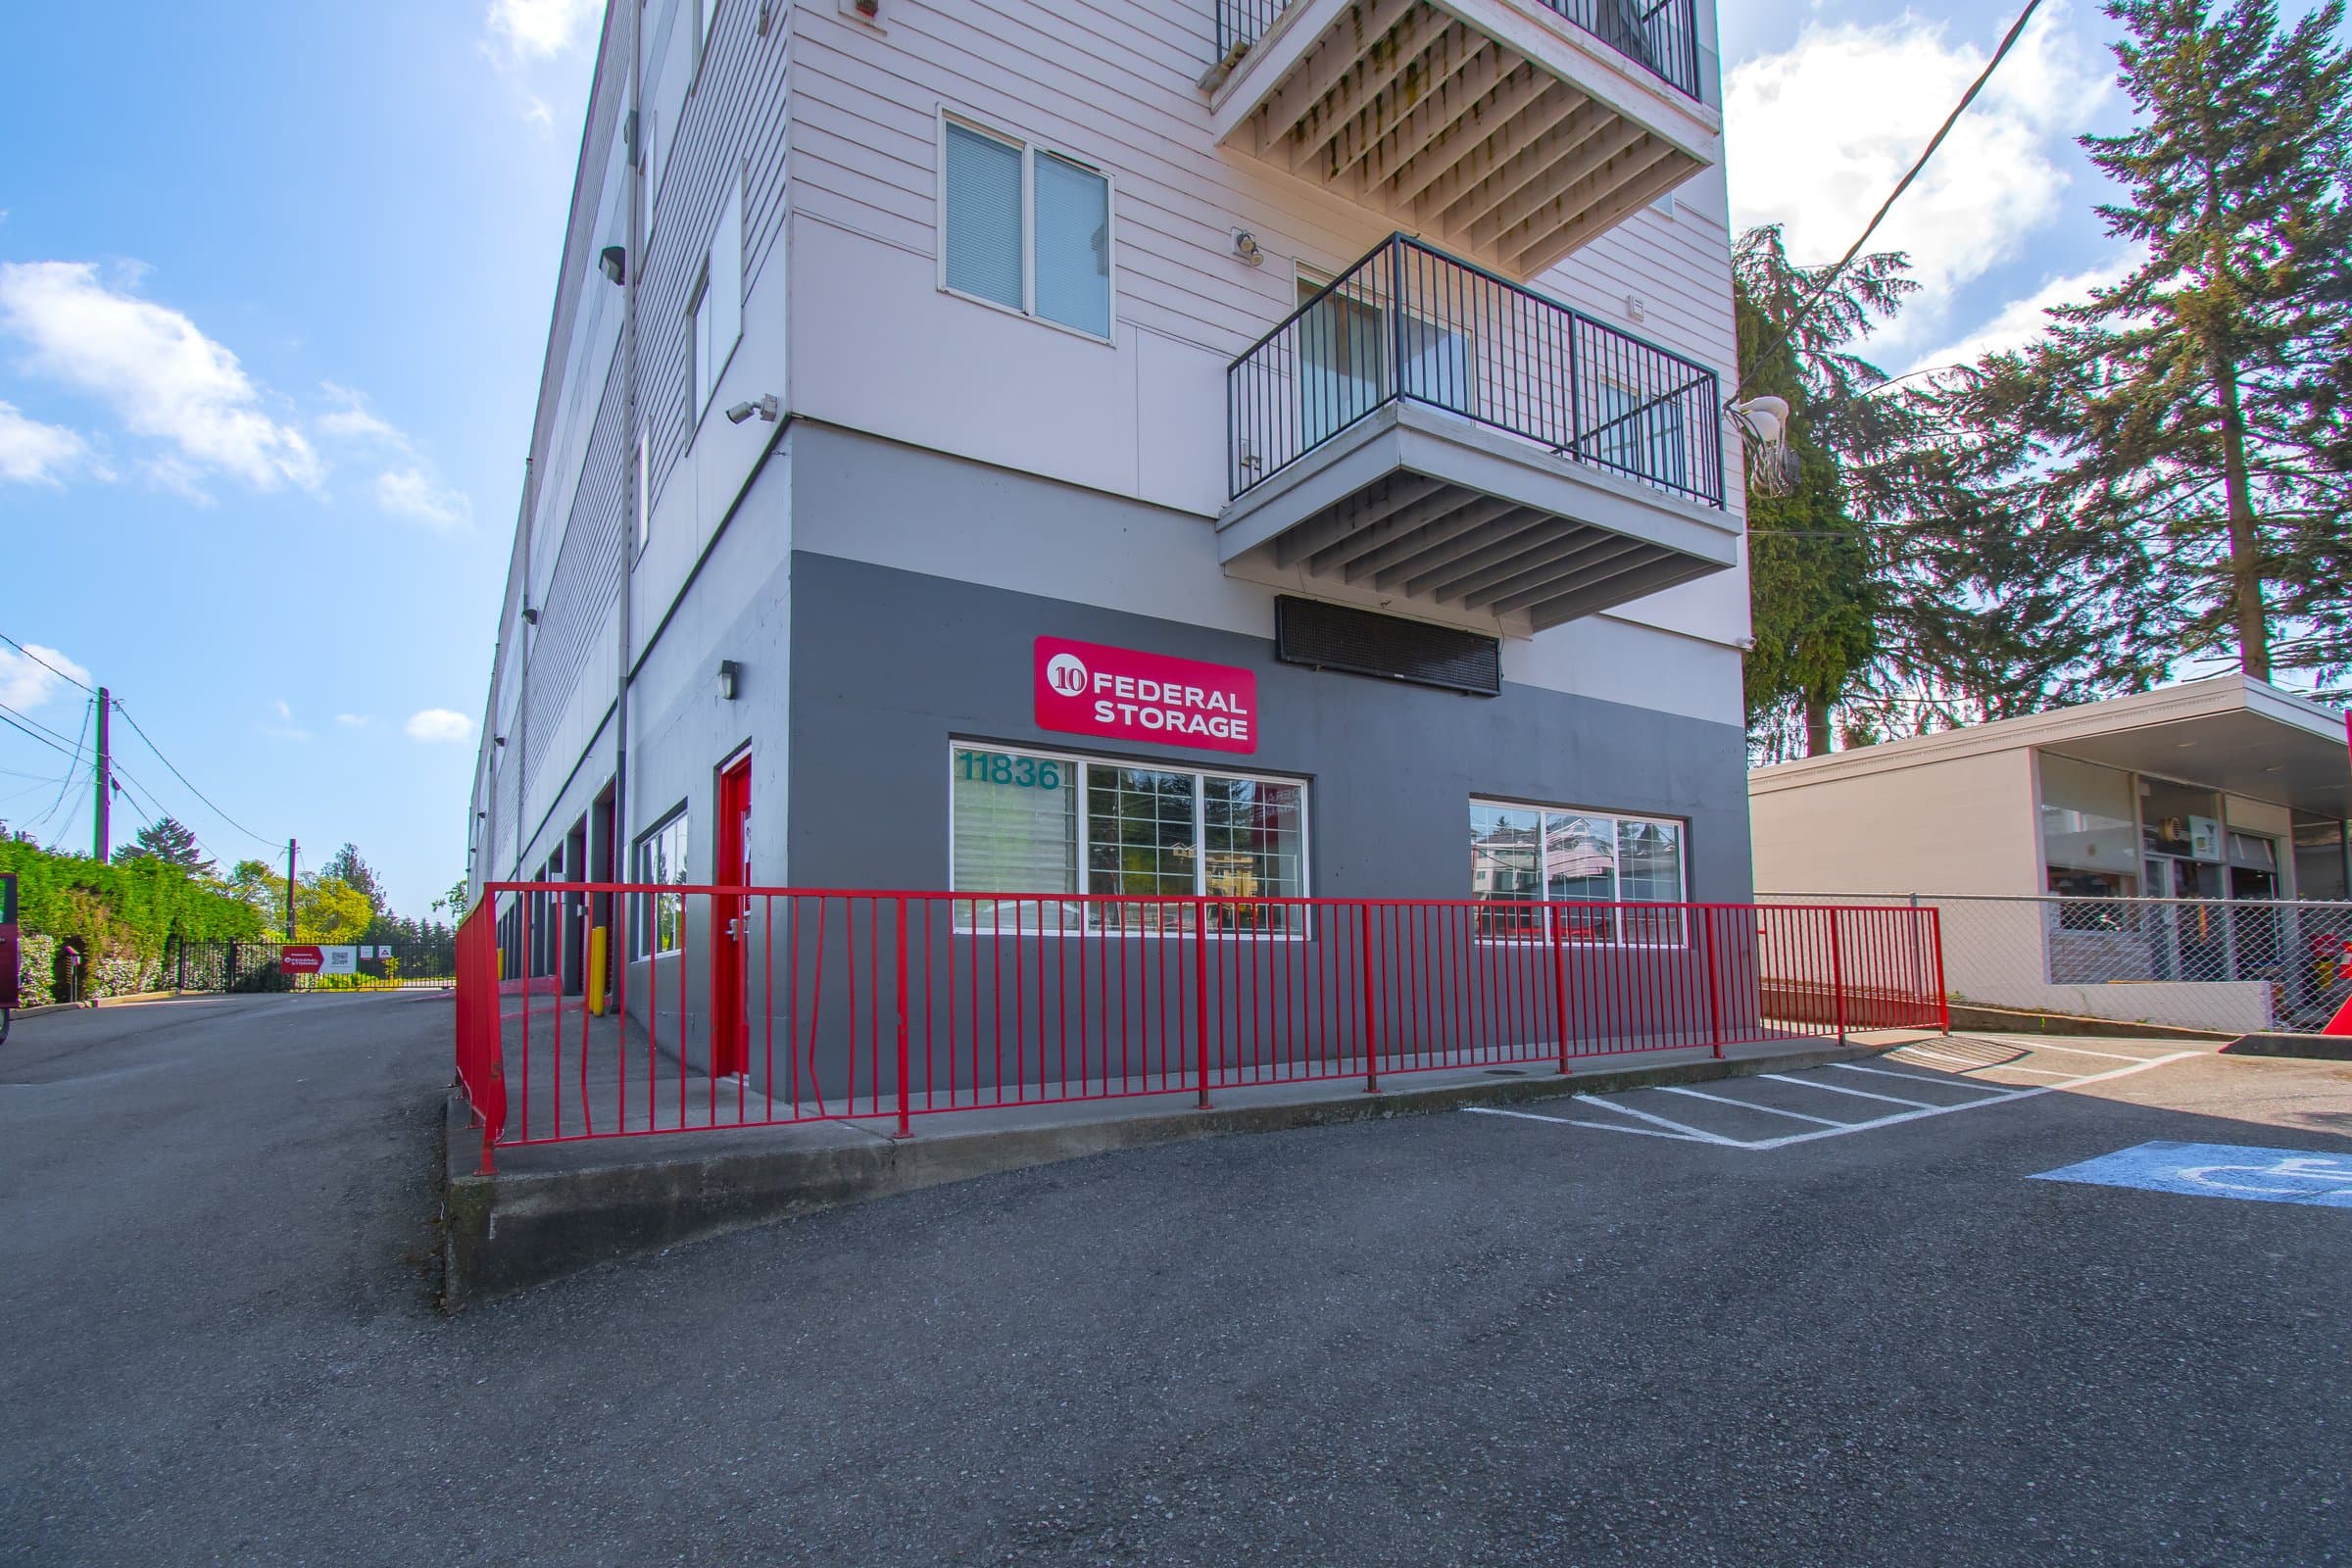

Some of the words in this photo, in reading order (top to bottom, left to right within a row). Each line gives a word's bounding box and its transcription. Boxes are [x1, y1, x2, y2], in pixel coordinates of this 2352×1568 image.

[1054, 666, 1085, 692] 10
[1094, 672, 1248, 714] FEDERAL
[1094, 700, 1249, 741] STORAGE
[958, 752, 1059, 791] 11836
